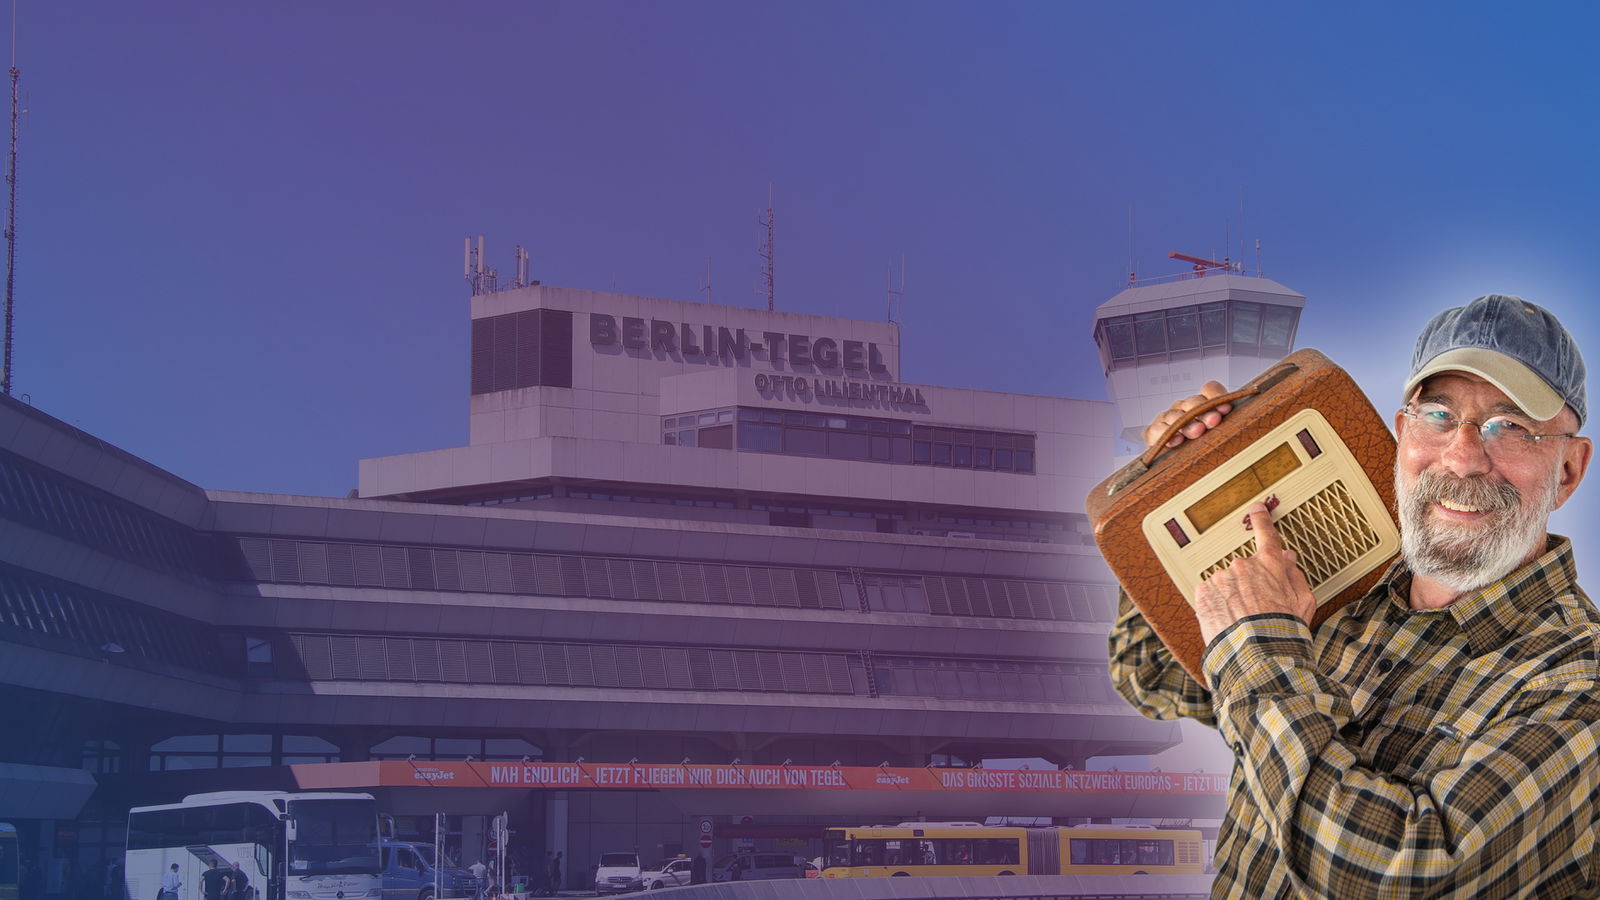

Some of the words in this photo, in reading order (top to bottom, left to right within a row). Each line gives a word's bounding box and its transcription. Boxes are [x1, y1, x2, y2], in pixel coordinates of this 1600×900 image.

[589, 312, 887, 373] BERLIN-TEGEL
[754, 373, 808, 396] OTTO
[813, 378, 927, 406] LILIENTHAL
[414, 771, 456, 781] easyJet
[490, 766, 519, 784] NAH
[523, 766, 580, 784] ENDLICH
[594, 767, 631, 784] JETZT
[634, 767, 684, 785] FLIEGEN
[689, 768, 712, 785] WIR
[716, 768, 745, 785] DICH
[748, 768, 781, 785] AUCH
[783, 769, 807, 786] VON
[810, 769, 846, 786] TEGEL
[875, 775, 911, 785] easyJet
[942, 772, 964, 788] DAS
[1018, 772, 1062, 789] SOZIALE
[1065, 773, 1122, 790] NETZWERK
[1124, 775, 1172, 791] EUROPAS
[1183, 776, 1211, 791] JETZT
